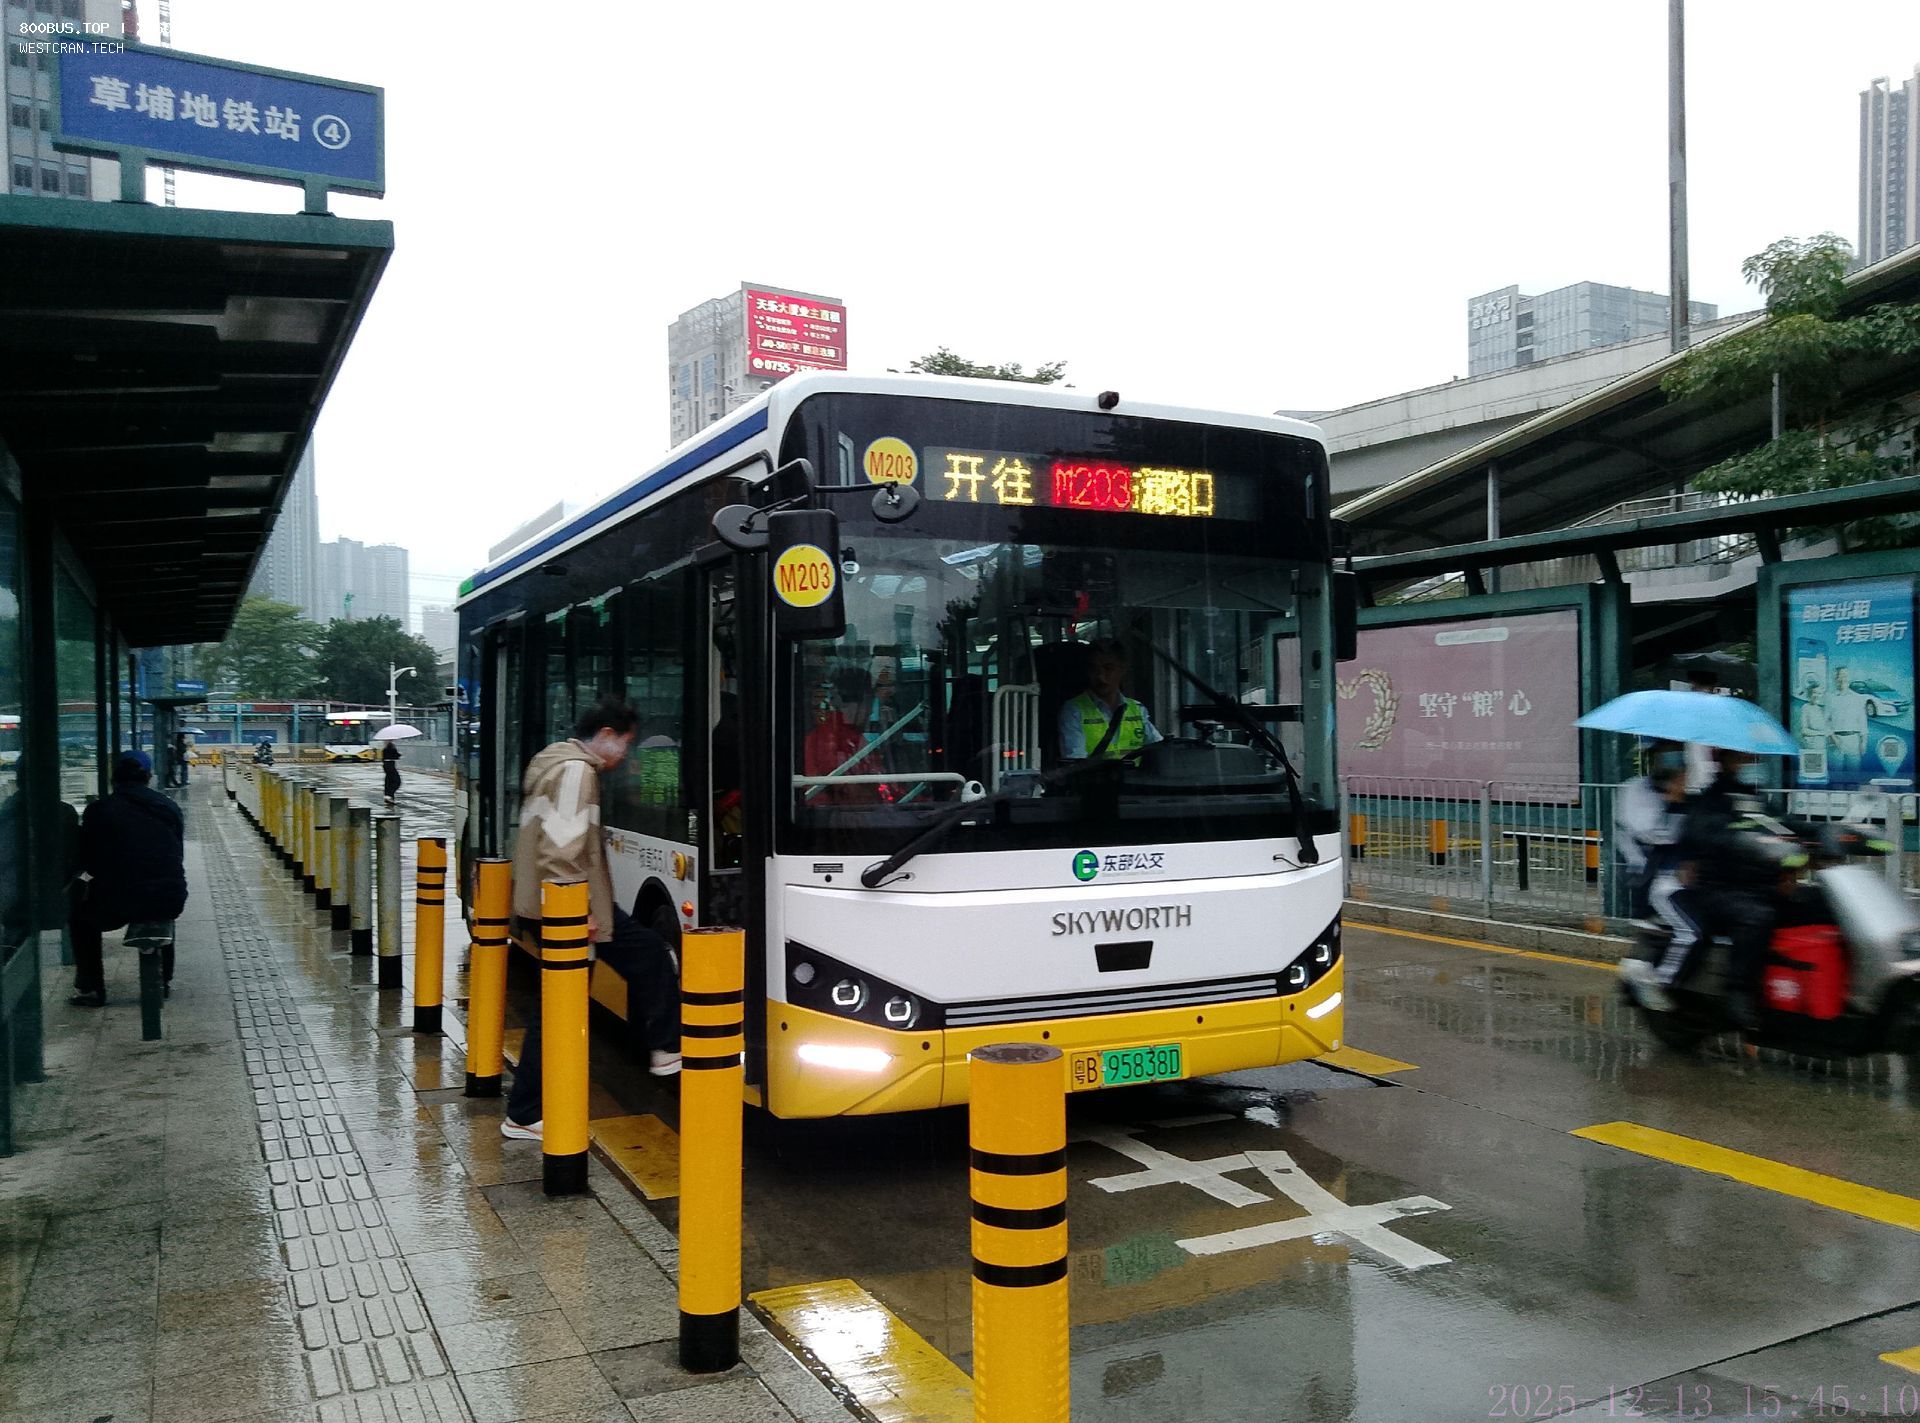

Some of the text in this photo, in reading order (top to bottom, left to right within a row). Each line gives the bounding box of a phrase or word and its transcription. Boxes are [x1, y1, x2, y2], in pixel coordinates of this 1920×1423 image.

[89, 75, 301, 141] 草埔地铁站
[869, 450, 913, 479] M203
[943, 453, 1034, 505] 开往
[1055, 466, 1131, 507] M203
[780, 562, 831, 593] M203
[1102, 853, 1165, 872] 东部公交
[1052, 904, 1192, 936] SKYWORTH
